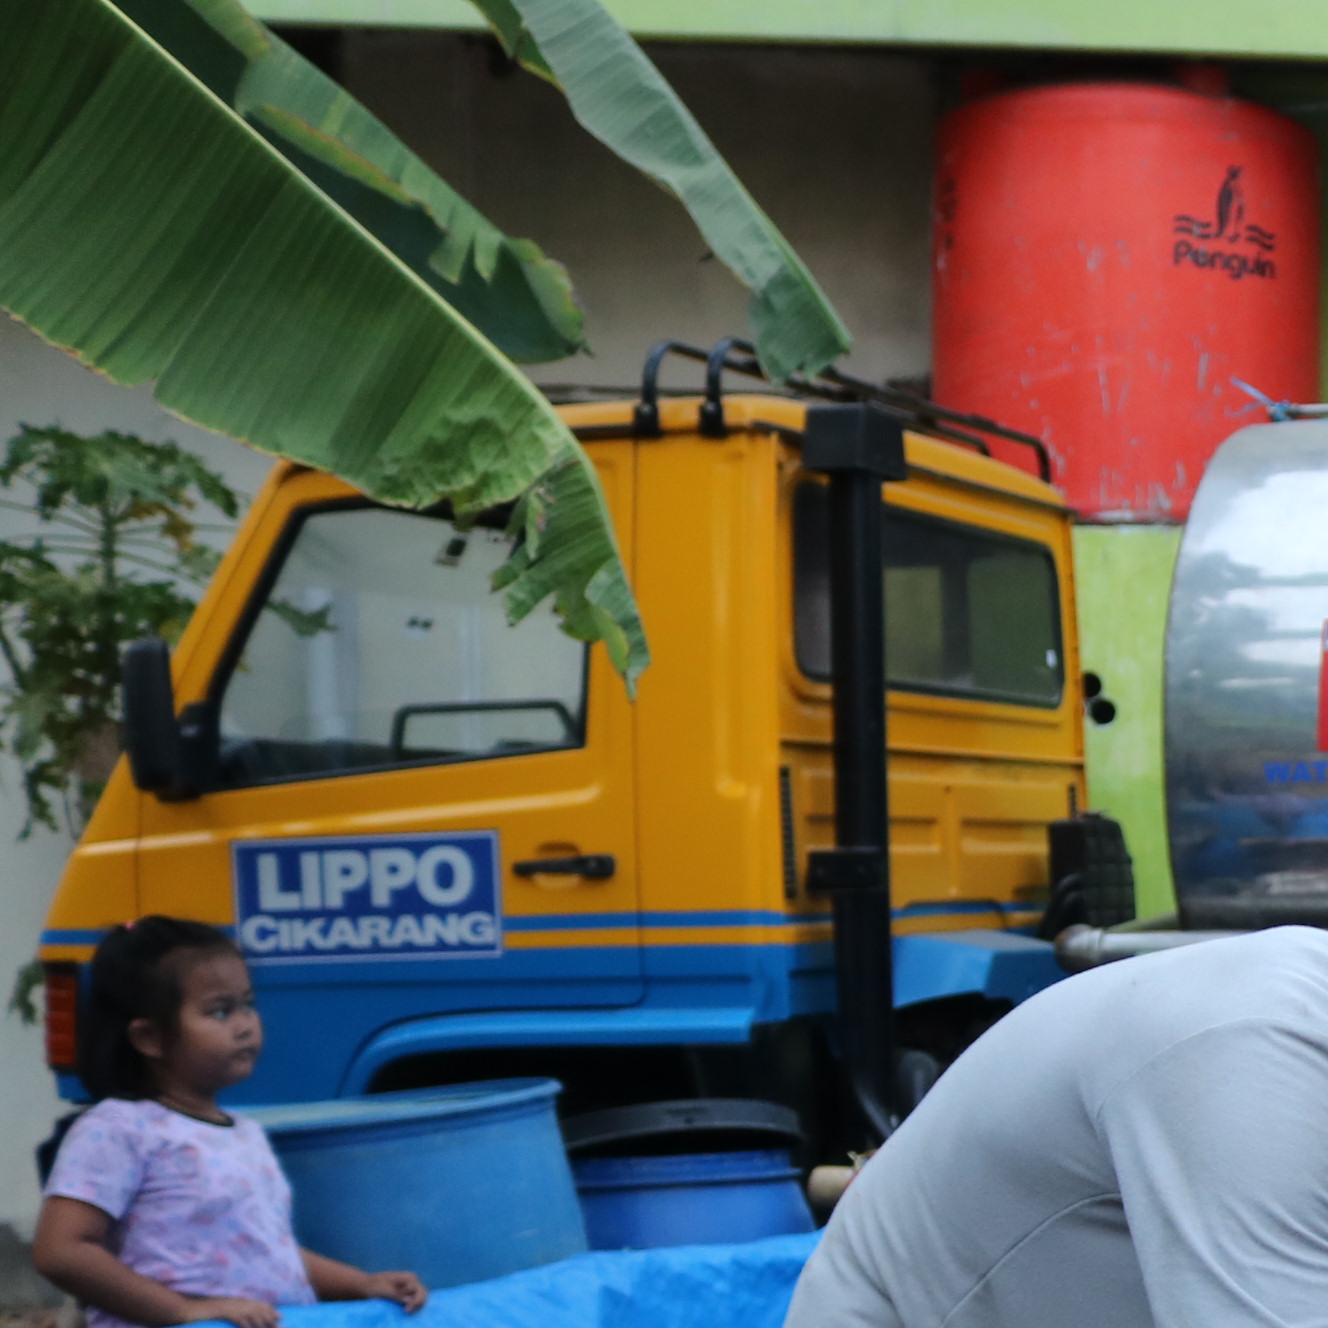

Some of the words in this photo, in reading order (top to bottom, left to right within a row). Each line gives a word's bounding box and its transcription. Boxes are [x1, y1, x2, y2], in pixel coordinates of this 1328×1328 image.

[1173, 240, 1276, 279] Penguin
[256, 844, 474, 911] LIPPO
[240, 911, 496, 951] CIKARANG
